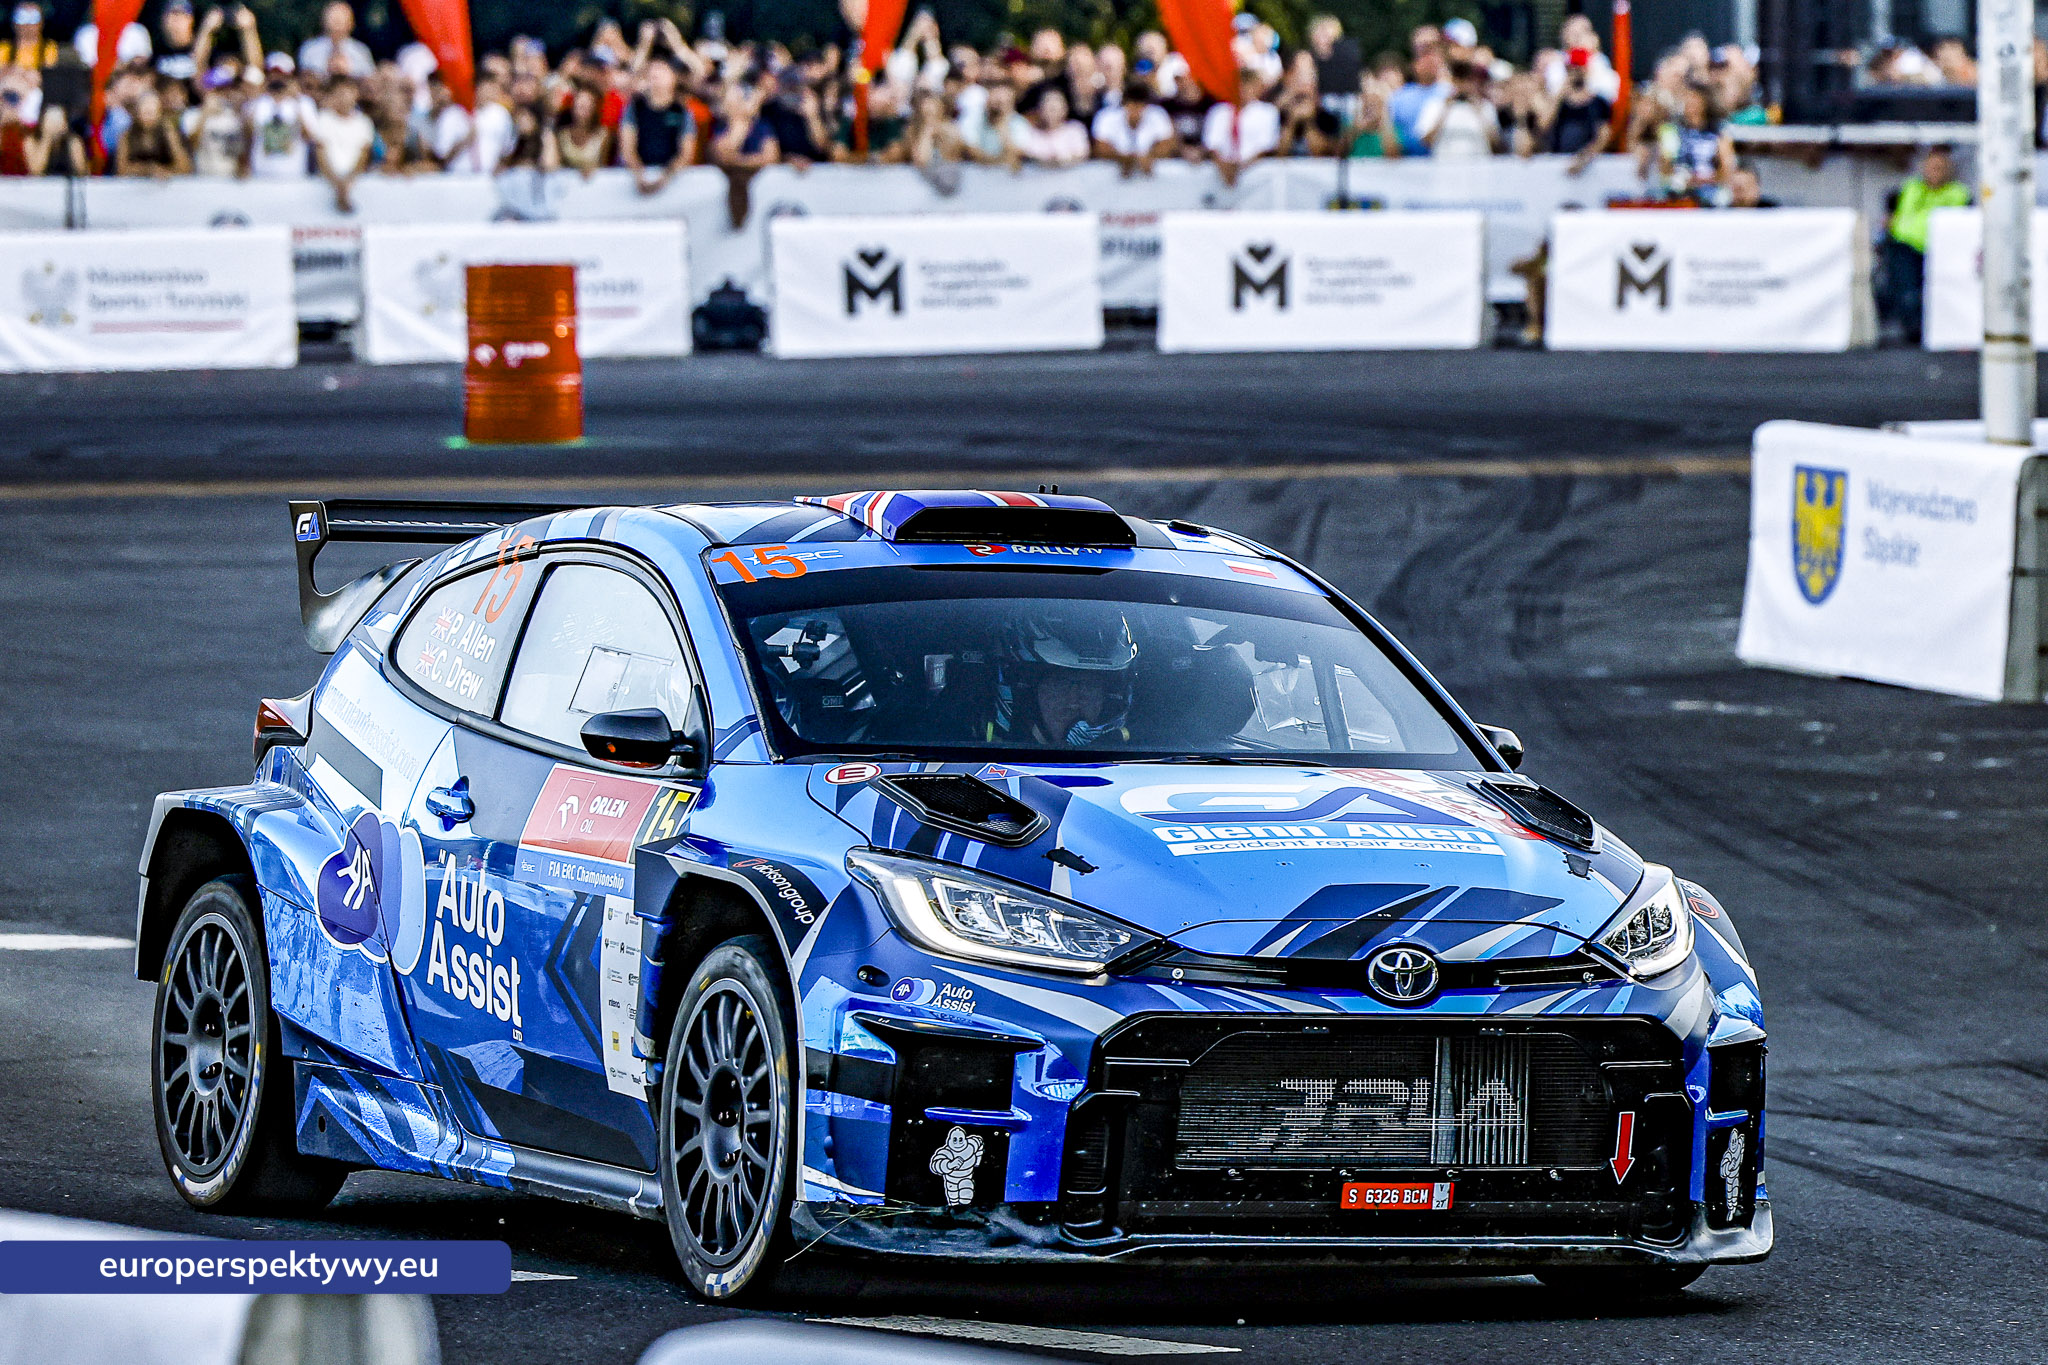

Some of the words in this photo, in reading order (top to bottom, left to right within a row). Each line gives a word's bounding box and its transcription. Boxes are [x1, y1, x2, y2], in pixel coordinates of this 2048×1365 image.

[472, 530, 536, 624] 15
[711, 545, 807, 583] 15
[445, 613, 465, 647] P.
[457, 620, 497, 664] Allen
[431, 649, 448, 684] C.
[444, 655, 485, 701] Drew
[589, 795, 630, 819] ORLEN
[642, 789, 692, 846] 15
[580, 818, 595, 834] OIL
[1151, 825, 1328, 842] Glenn
[1345, 823, 1497, 843] Allen
[1194, 839, 1309, 852] accident
[1316, 839, 1391, 850] repair
[1400, 841, 1482, 852] centre
[548, 860, 561, 878] FIA
[562, 863, 578, 880] ERC
[576, 865, 625, 893] Championship
[751, 863, 816, 925] dicksongroup
[436, 852, 506, 947] Auto
[427, 920, 523, 1028] Assist
[940, 983, 974, 1000] Auto
[930, 995, 977, 1014] Assist
[1348, 1188, 1359, 1204] S
[1365, 1188, 1400, 1204] 6326
[1402, 1188, 1429, 1204] BCM
